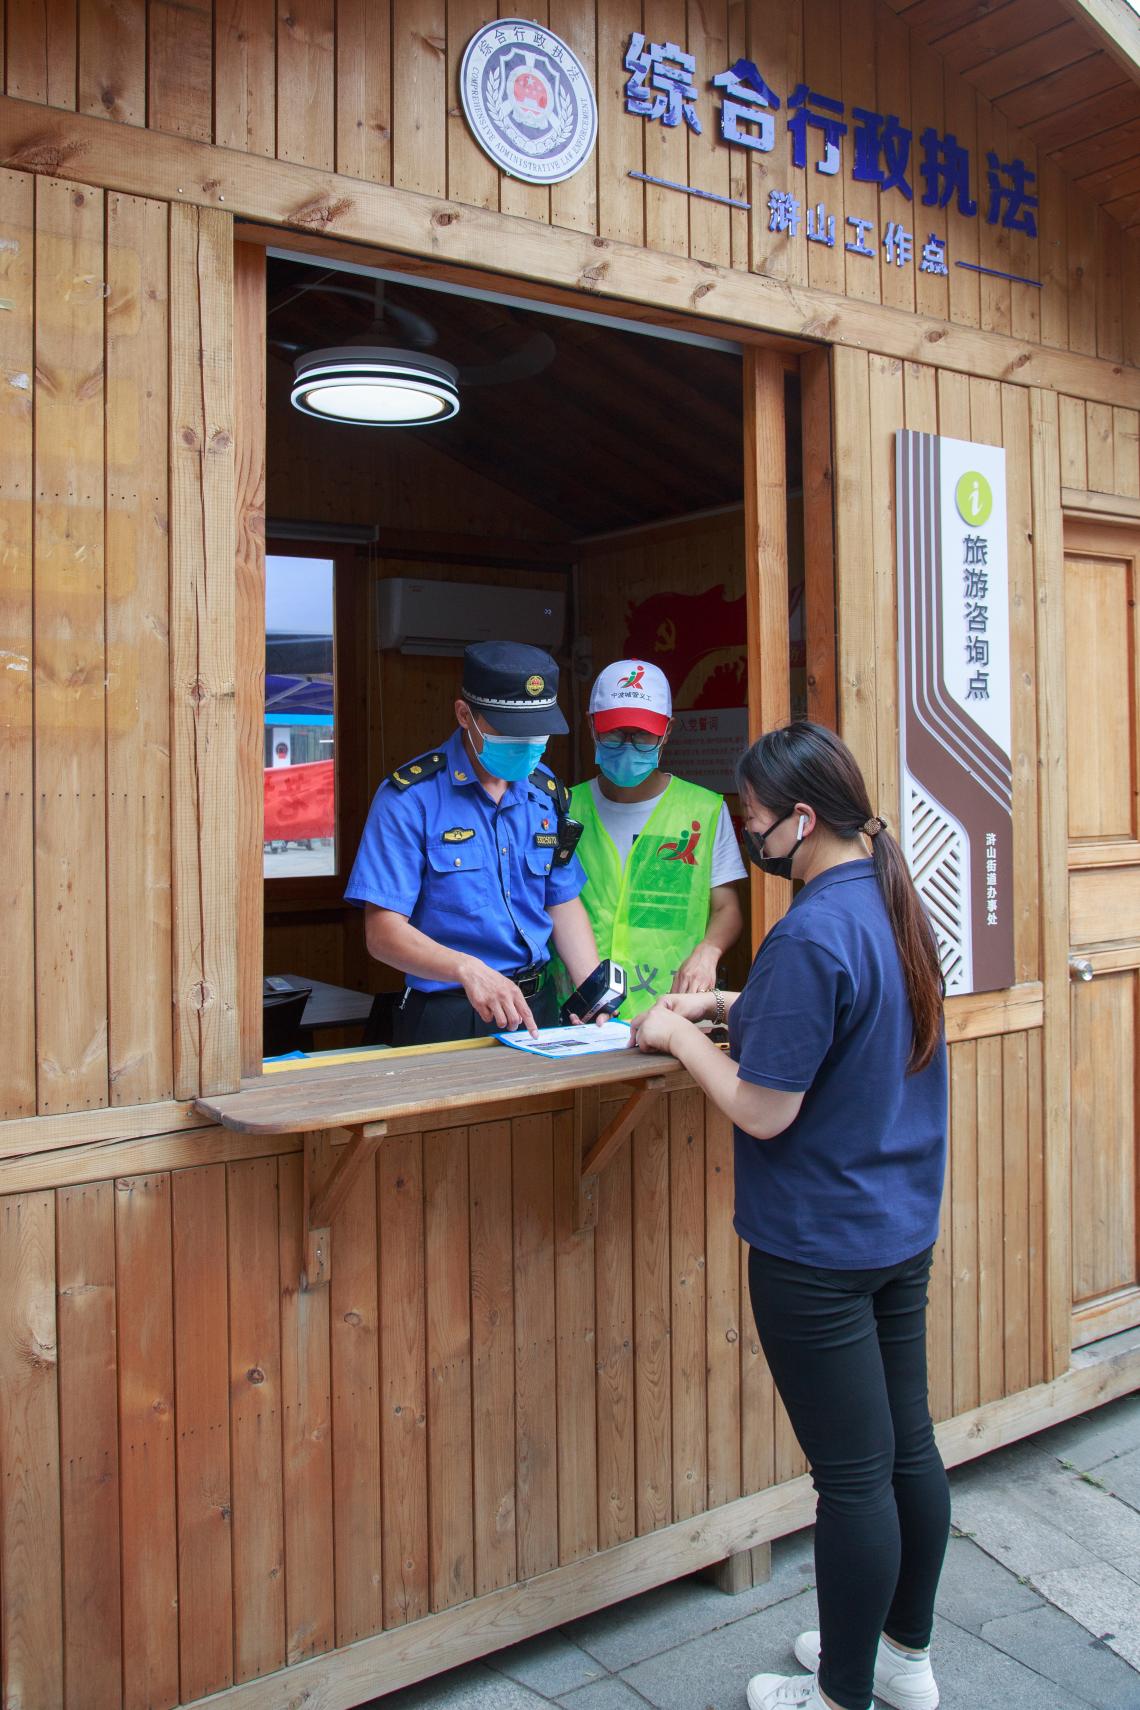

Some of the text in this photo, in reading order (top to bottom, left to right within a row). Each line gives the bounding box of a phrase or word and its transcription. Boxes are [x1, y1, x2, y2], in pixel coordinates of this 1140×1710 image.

[478, 26, 580, 83] 综合行政执法
[494, 142, 560, 172] ADMINISTRATIVE
[624, 32, 1039, 239] 综合行政执法
[767, 189, 949, 277] 浒山工作点
[963, 534, 990, 700] 旅游咨询点
[985, 832, 998, 926] 浒山街道办事处
[630, 964, 677, 996] 义
